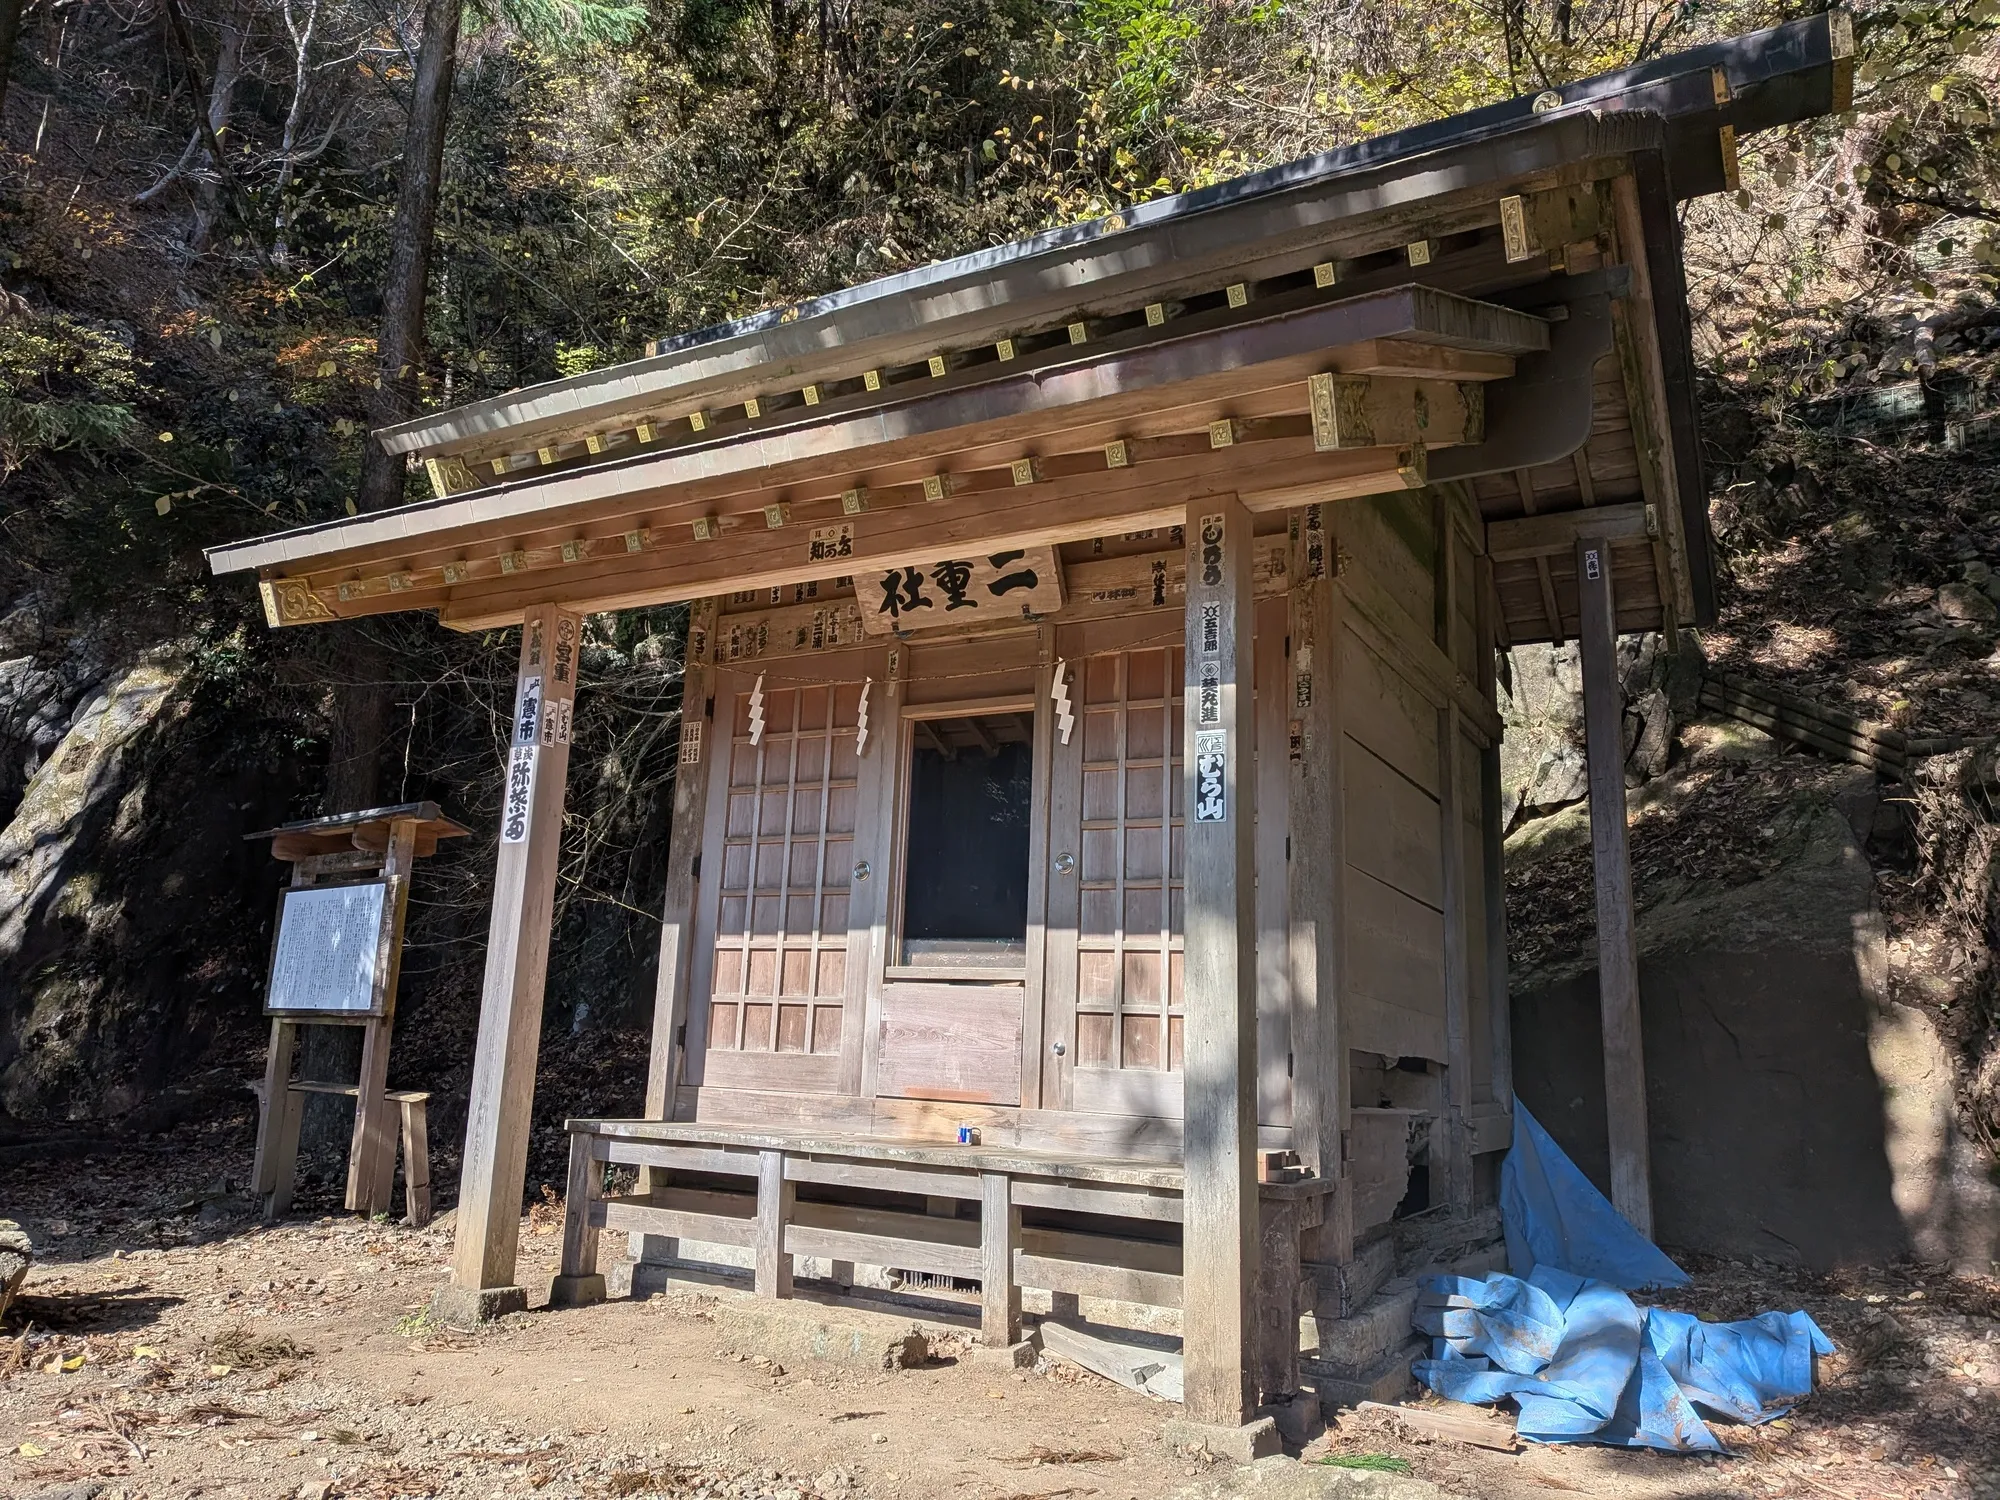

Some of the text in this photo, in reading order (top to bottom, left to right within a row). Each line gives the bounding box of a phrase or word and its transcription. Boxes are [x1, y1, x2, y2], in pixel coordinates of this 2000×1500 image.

[878, 549, 1038, 618] 二重社
[1204, 618, 1218, 652] 五吉郎
[1198, 754, 1223, 819] むら山
